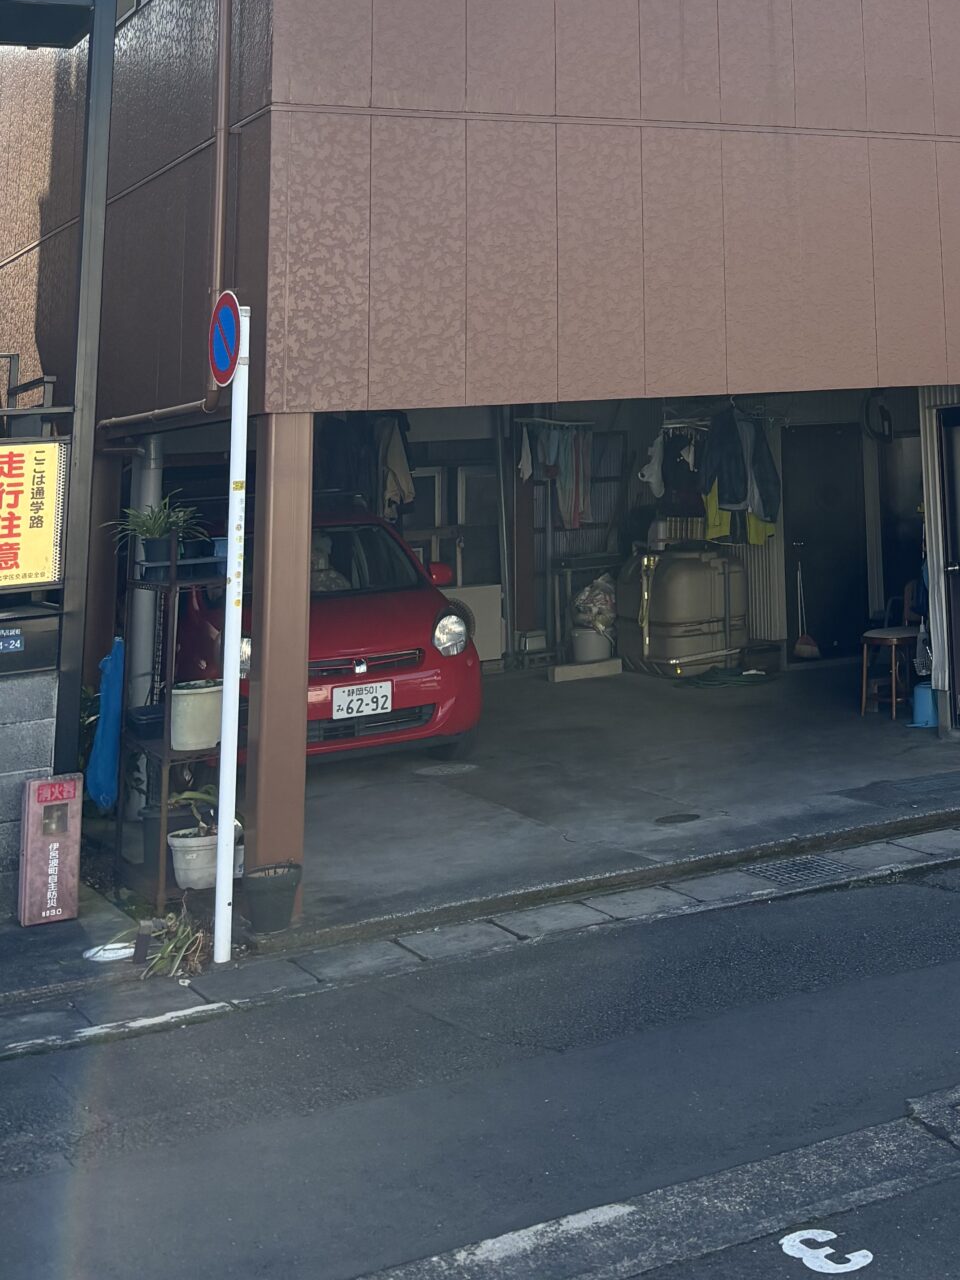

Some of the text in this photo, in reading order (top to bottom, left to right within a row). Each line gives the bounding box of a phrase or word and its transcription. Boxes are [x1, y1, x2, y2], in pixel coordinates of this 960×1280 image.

[29, 450, 46, 529] ここは通学路
[347, 685, 378, 697] 静岡501
[346, 694, 389, 715] 62-92
[38, 782, 75, 801] 消火器
[778, 1229, 873, 1273] 3
